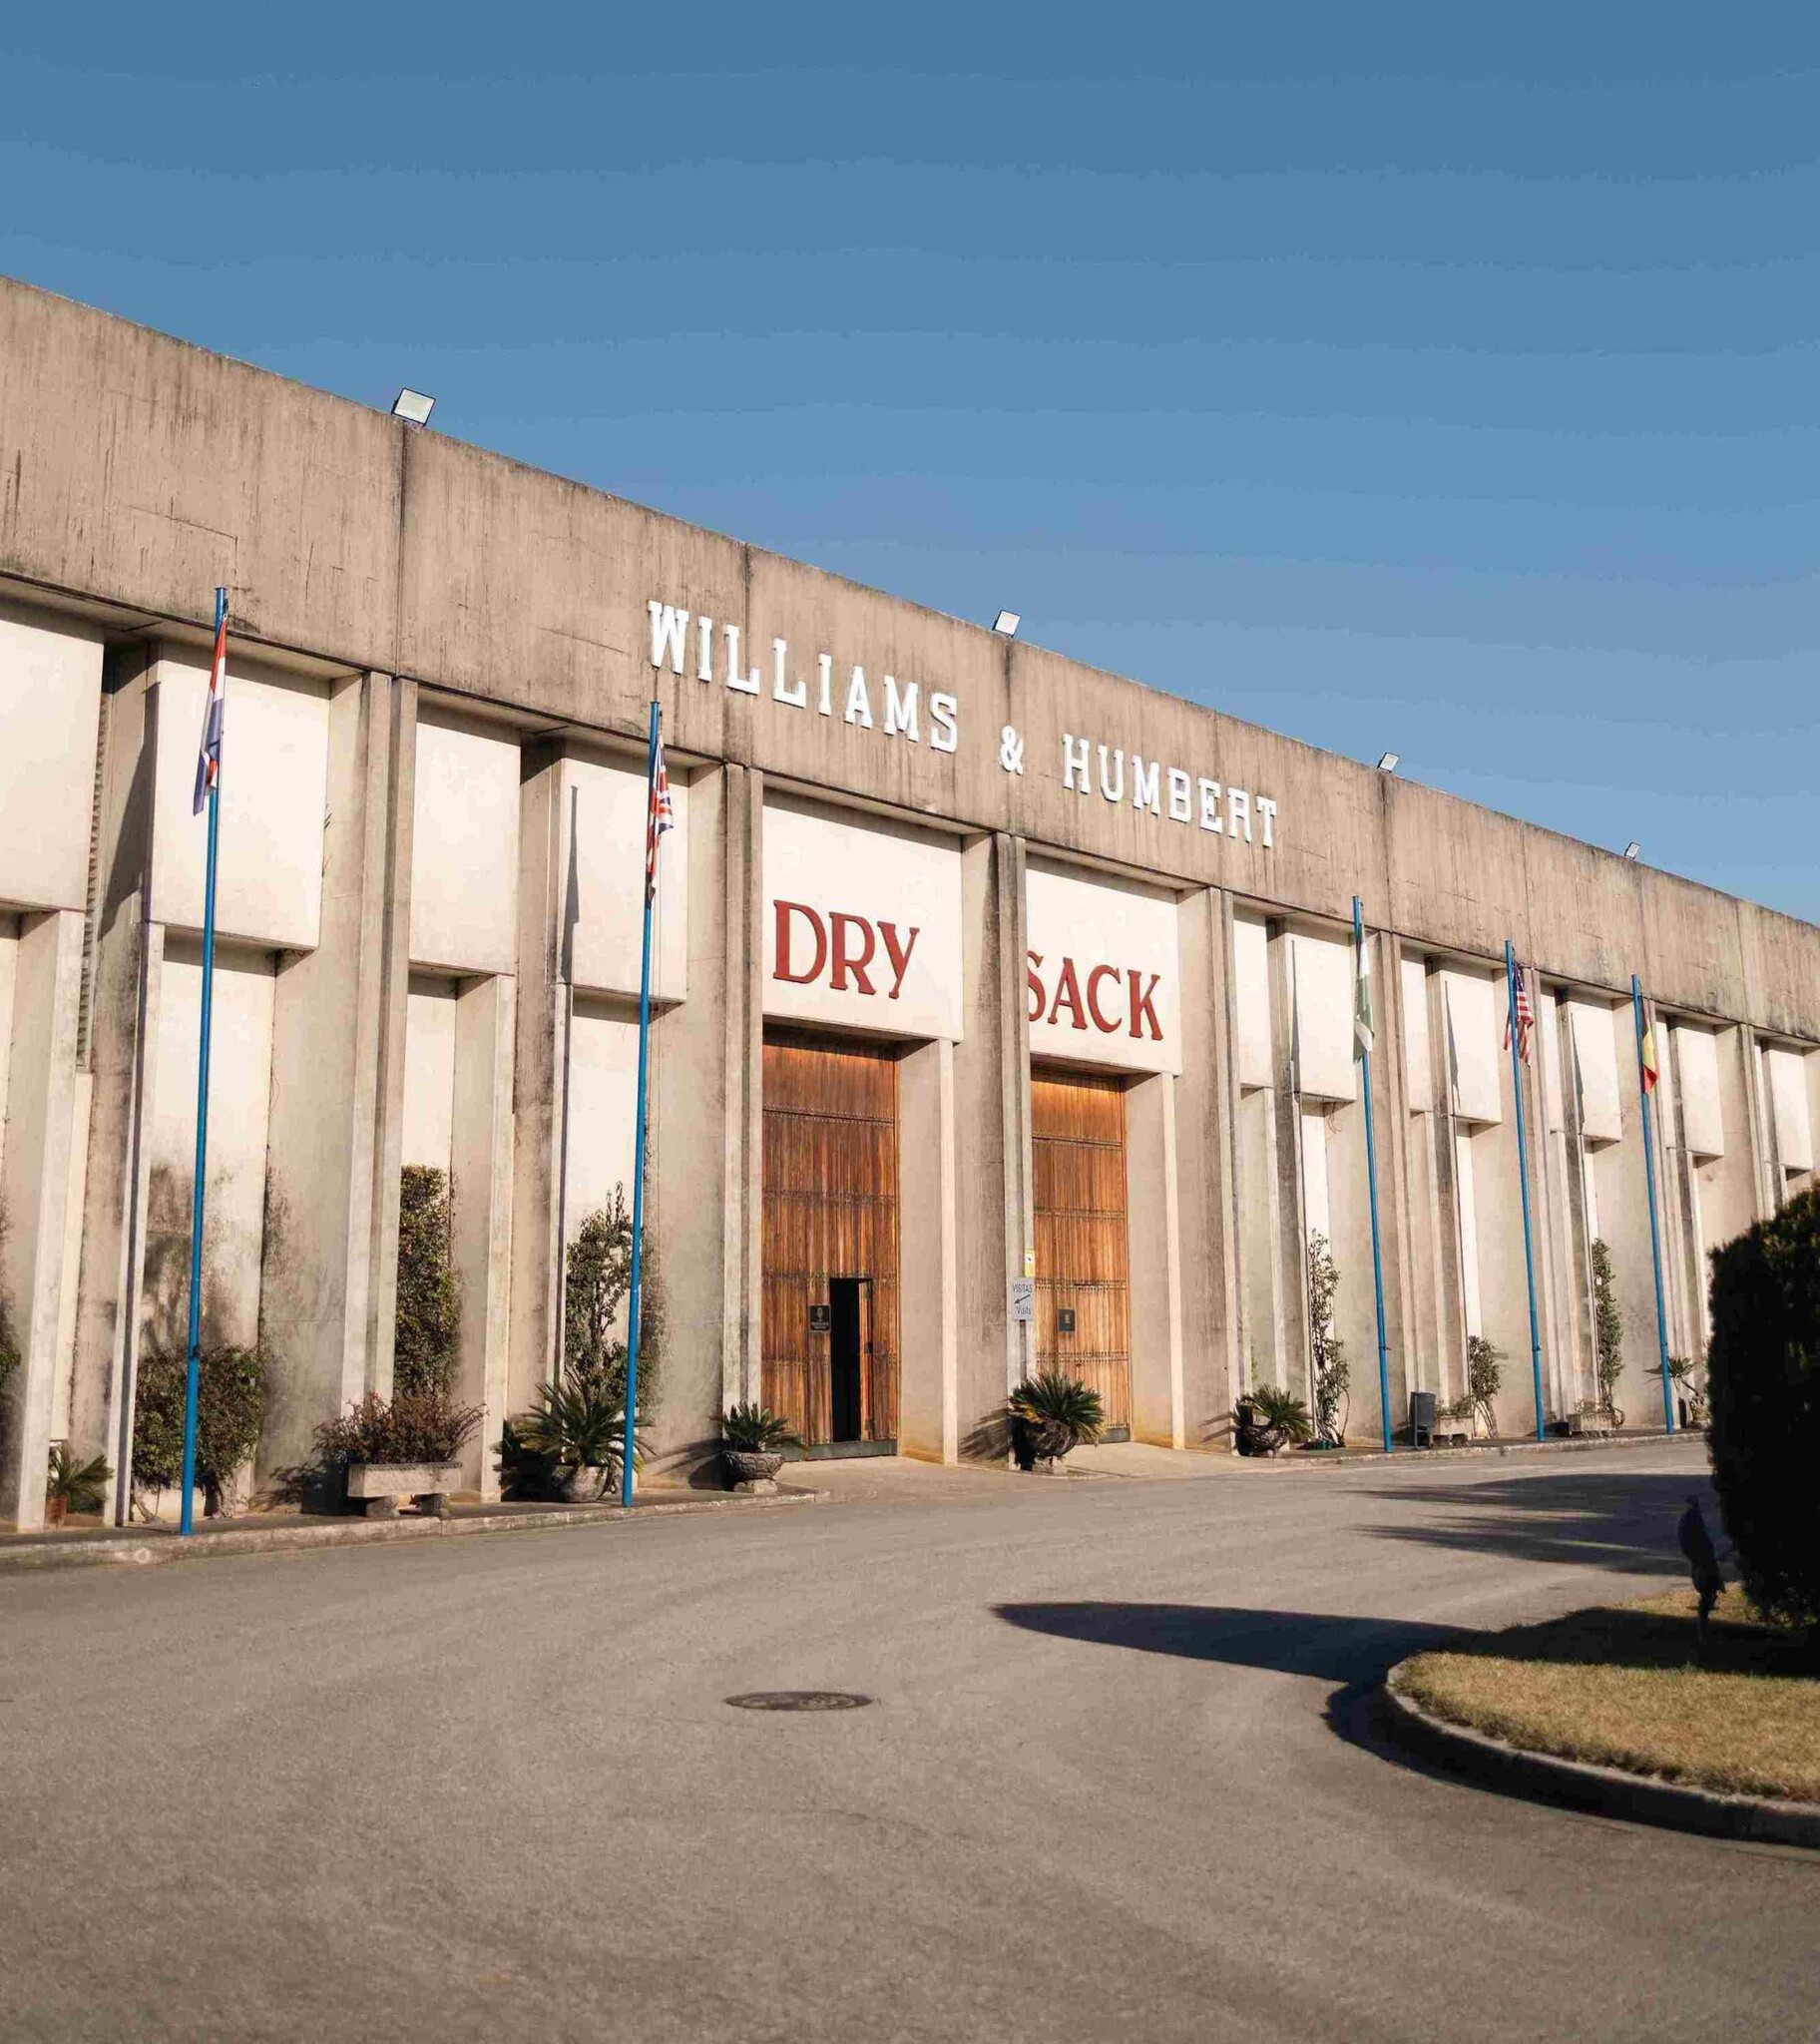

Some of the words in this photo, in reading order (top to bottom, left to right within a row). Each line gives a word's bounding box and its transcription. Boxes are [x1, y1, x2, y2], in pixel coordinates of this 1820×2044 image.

[648, 600, 958, 754] WILLIAMS
[999, 725, 1024, 775] &
[1062, 734, 1277, 847] HUMBERT
[772, 899, 920, 999] DRY
[1027, 950, 1163, 1041] SACK
[1012, 1283, 1033, 1293] VISITAS
[1016, 1305, 1032, 1315] Visits
